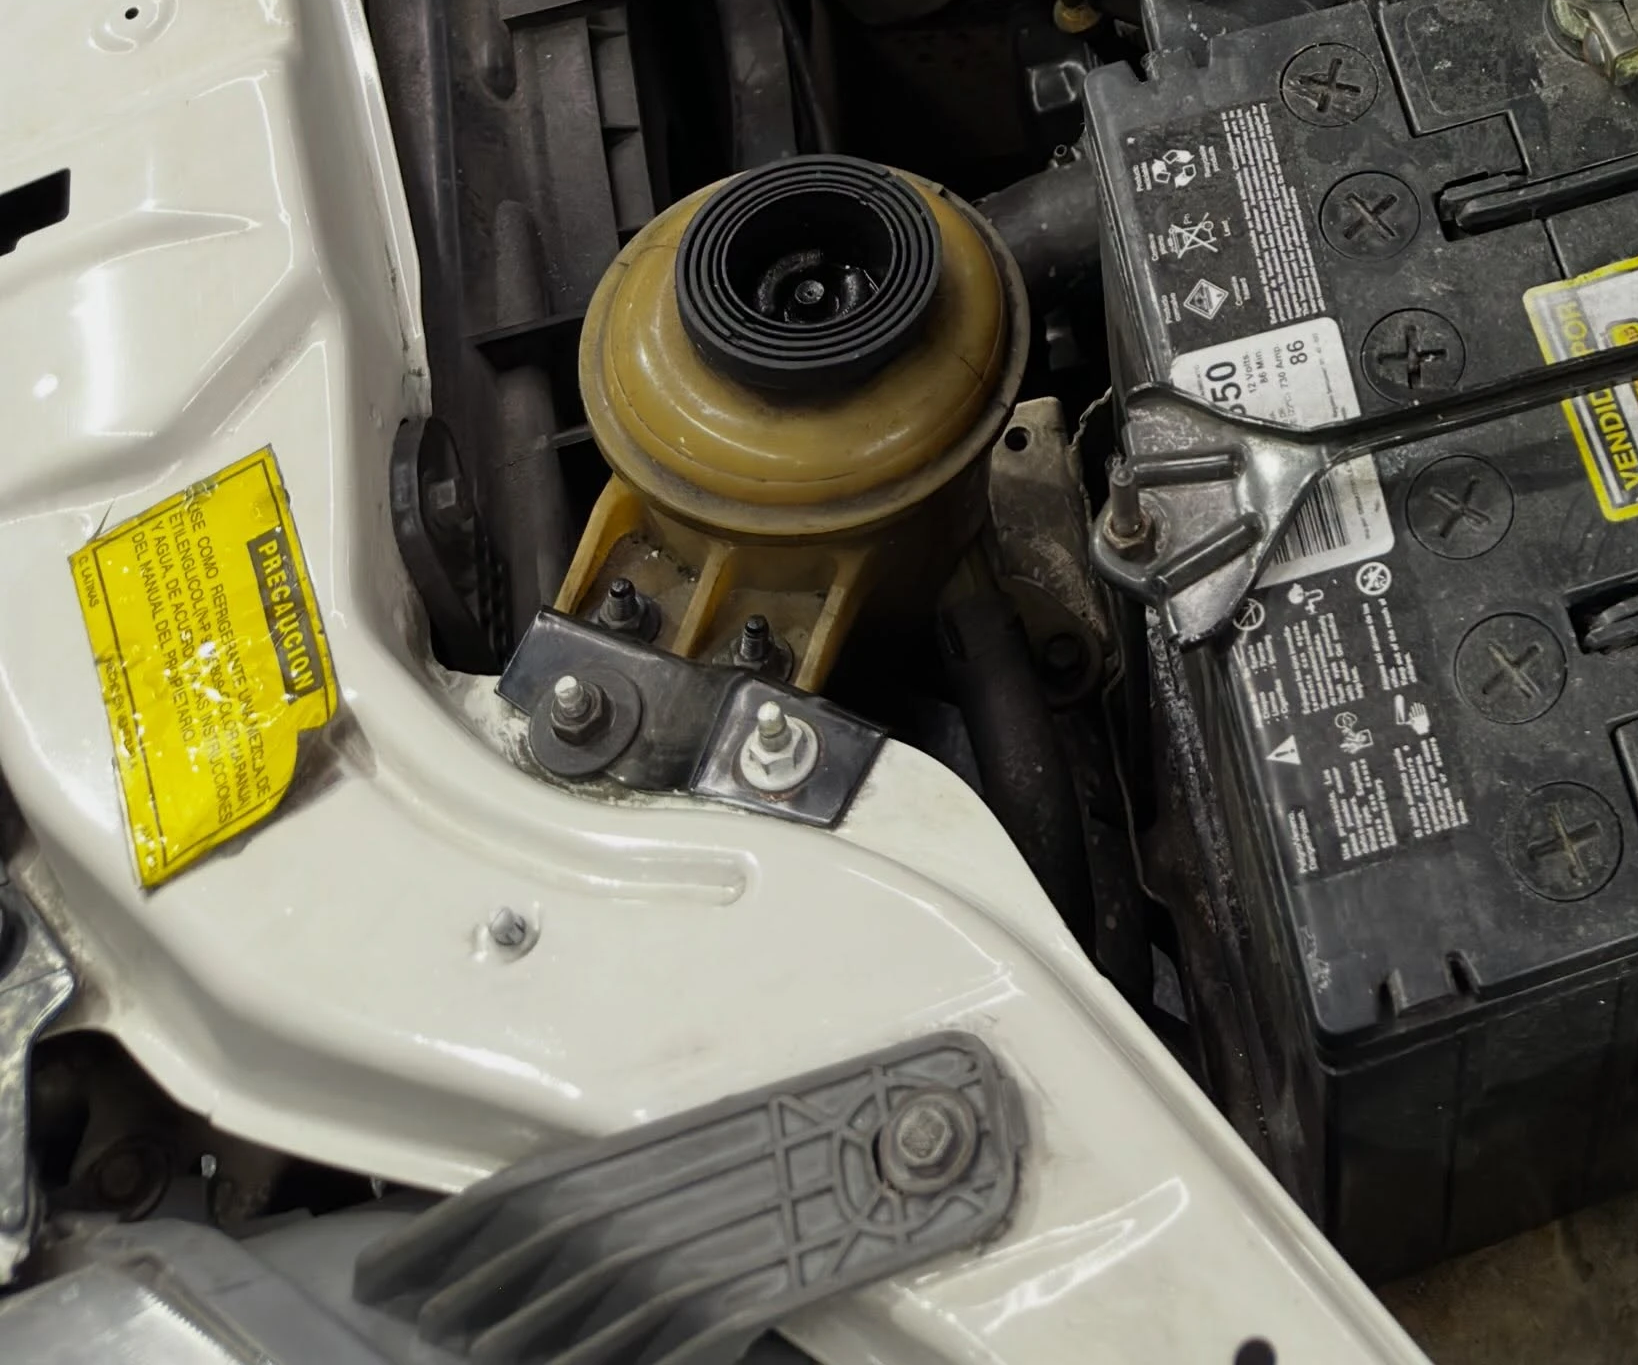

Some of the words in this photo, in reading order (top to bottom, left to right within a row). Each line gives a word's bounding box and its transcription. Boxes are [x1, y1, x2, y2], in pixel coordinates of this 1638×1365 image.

[1557, 300, 1596, 357] POR
[1267, 342, 1287, 369] Amp.
[1282, 337, 1310, 367] 86
[1244, 381, 1259, 394] 12
[1274, 370, 1291, 389] 730
[149, 519, 165, 536] Y
[186, 498, 206, 534] USE
[130, 529, 150, 563] DEL
[152, 530, 176, 580] AGUA,
[195, 532, 219, 582] COMO
[138, 557, 165, 621] MANUAL
[164, 575, 182, 602] DE
[258, 538, 315, 693] PRECAUCION
[153, 617, 173, 651] DEL
[208, 580, 247, 691] REFRIGERANTE
[235, 686, 255, 721] UNA
[242, 717, 269, 778] MEZCLA
[194, 709, 236, 825] INSTRUCCIONES
[253, 774, 271, 799] DE
